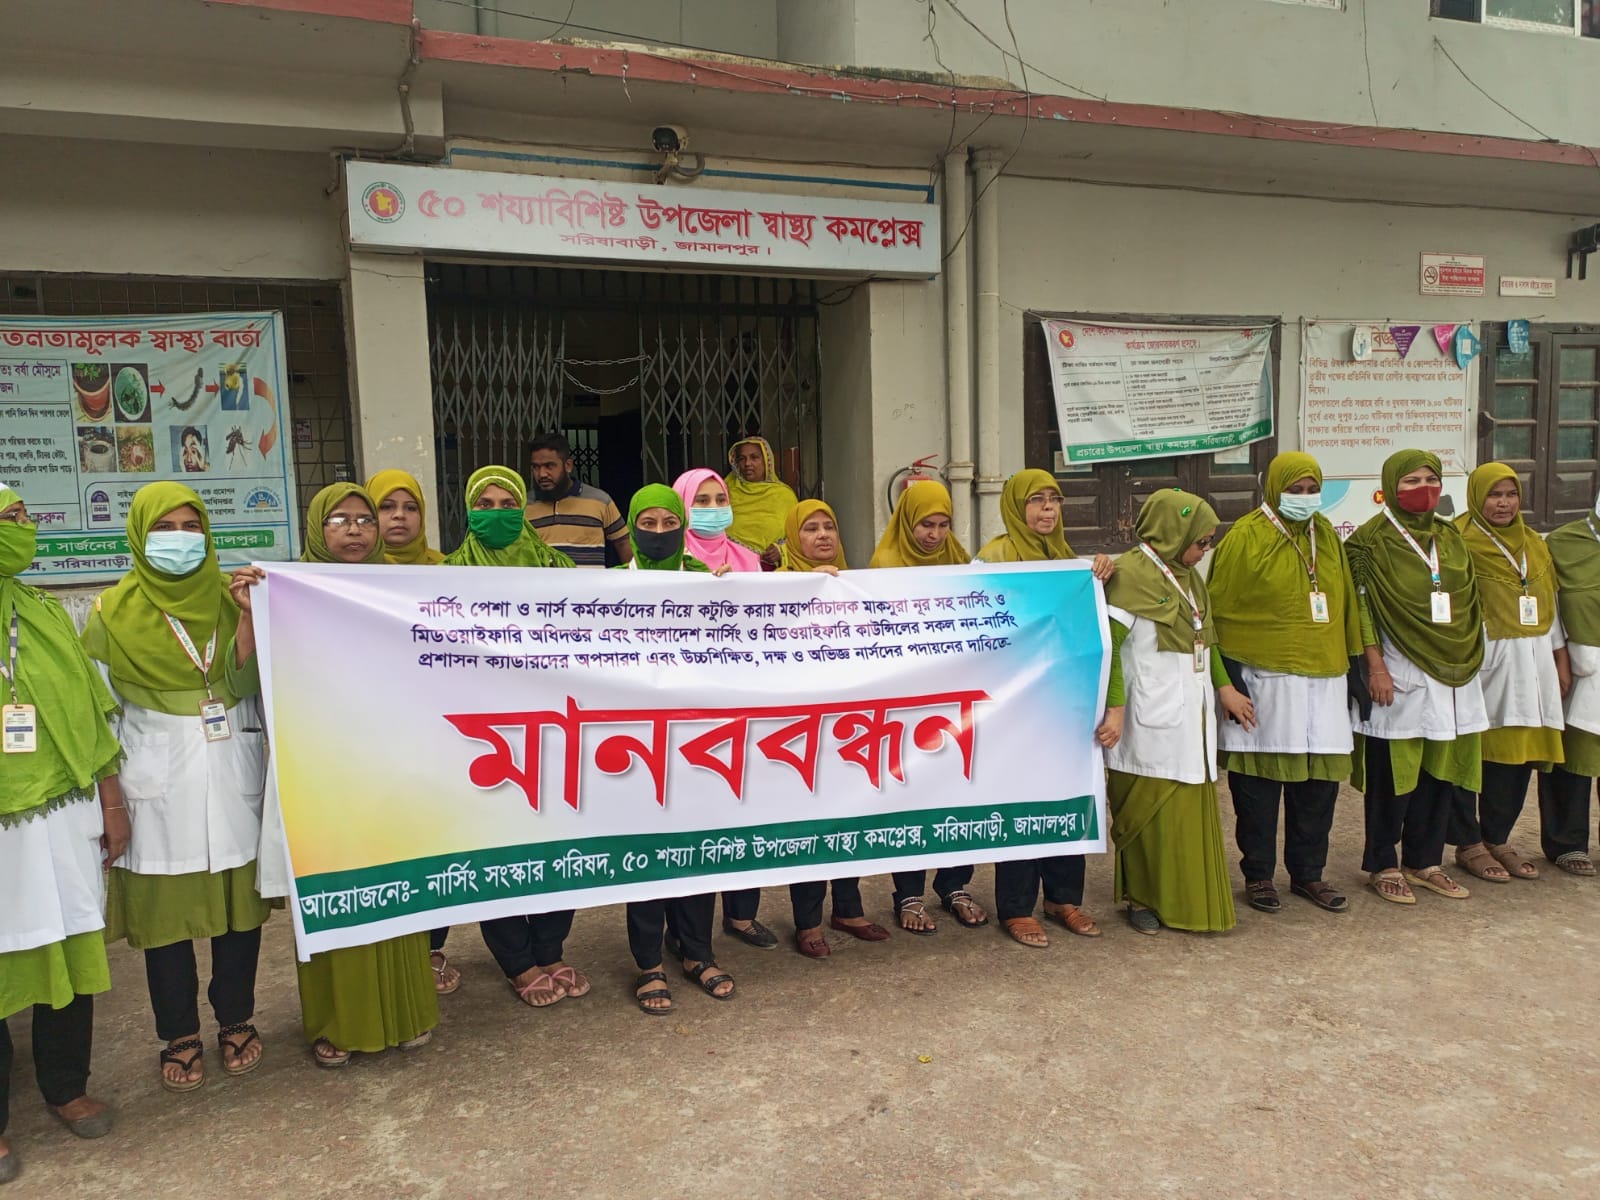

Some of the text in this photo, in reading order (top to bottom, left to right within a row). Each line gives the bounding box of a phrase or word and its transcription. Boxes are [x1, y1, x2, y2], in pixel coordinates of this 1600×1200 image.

[417, 189, 466, 218] ৫০
[477, 188, 628, 229] শয্যাবিশিষ্ট
[636, 193, 752, 238] উপজেলা
[758, 211, 817, 247] স্বাস্থ্য
[823, 216, 923, 250] কমপ্লেক্স
[0, 323, 263, 355] তনতামূলক স্বাস্থ্য বার্তা
[14, 361, 29, 377] বর্ষা
[32, 361, 61, 379] মৌসুমে
[56, 539, 117, 553] সার্জনের
[418, 596, 463, 618] নার্সিং
[471, 600, 511, 618] পেশা
[517, 602, 529, 616] ও
[536, 597, 569, 618] নার্স
[571, 598, 655, 618] কর্মকর্তাদের
[661, 599, 691, 618] নিয়ে
[744, 602, 775, 619] করায়
[779, 597, 858, 618] মহাপরিচালক
[862, 599, 908, 617] মাকসুরা
[913, 599, 930, 616] নূর
[935, 598, 954, 612] সহ
[958, 590, 992, 611] নার্সিং
[995, 593, 1005, 606] ও
[412, 610, 1018, 645] মিডওয়াইফারি অধিদপ্তর এবং বাংলাদেশ নার্সিং ও মিডওয়াইফারি কাউন্সিলের সকল নন-নার্সিং
[418, 635, 1012, 670] প্রশাসন ক্যাডারদের অপসারণ এবং উচ্চশিক্ষিত, দক্ষ ও অভিজ্ঞ নার্সদের পদায়নের দাবিতে-
[443, 689, 996, 813] মানববন্ধন
[426, 859, 480, 898] নার্সিং
[483, 858, 546, 890] সংস্কার
[552, 847, 616, 881] পরিষদ,
[621, 851, 648, 873] ৫০
[655, 844, 695, 869] শয্যা
[700, 836, 748, 866] বিশিষ্ট
[751, 831, 818, 860] উপজেলা
[824, 829, 860, 857] স্বাস্থ্য
[863, 824, 927, 852] কমপ্লেক্স,
[932, 811, 1008, 843] সরিষাবাড়ী,
